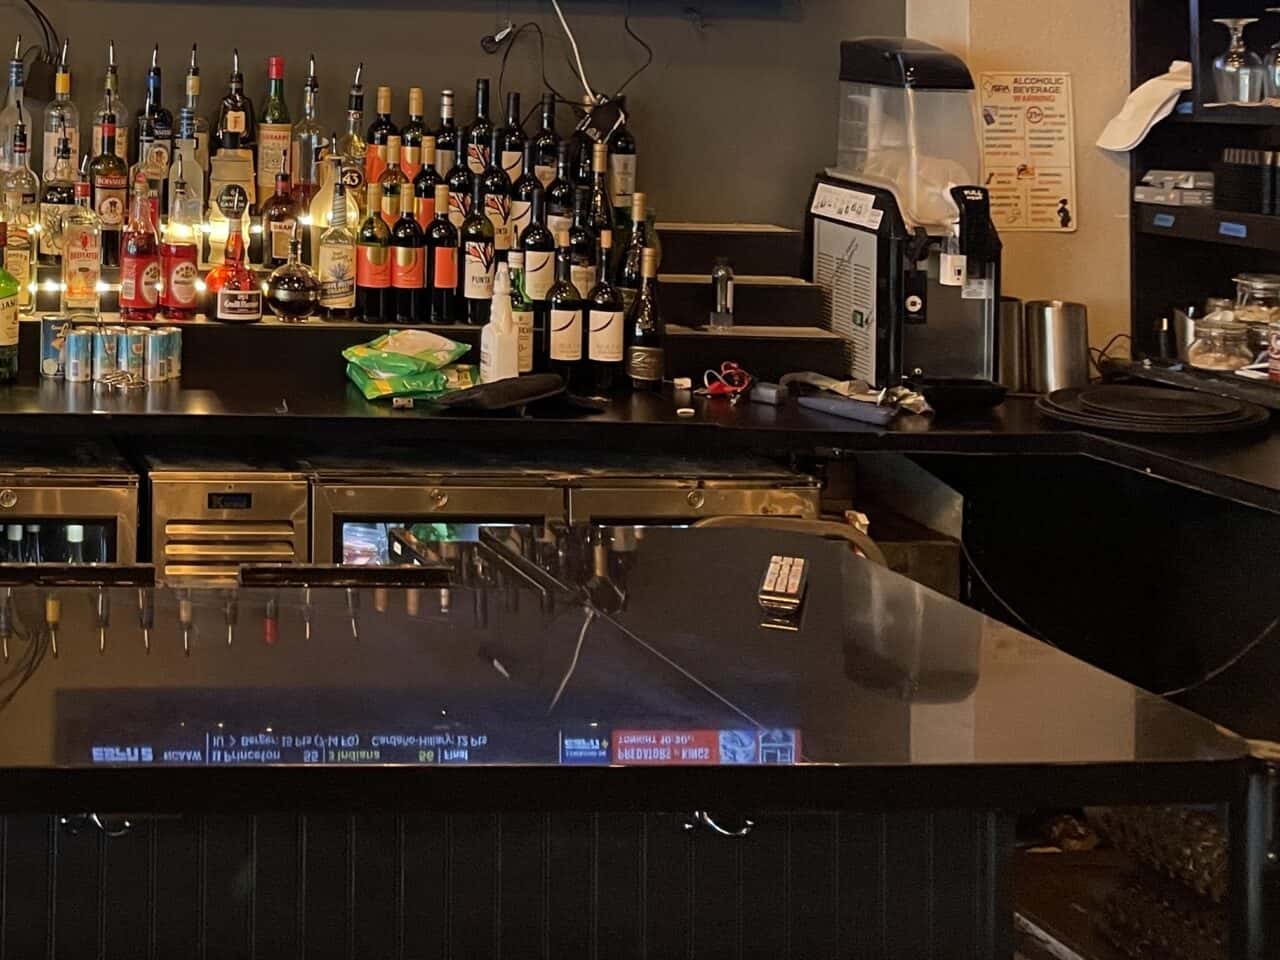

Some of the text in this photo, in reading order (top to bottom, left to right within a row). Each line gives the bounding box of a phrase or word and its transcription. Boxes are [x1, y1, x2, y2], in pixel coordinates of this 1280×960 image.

[1013, 77, 1064, 85] ALCOHOLIC
[1013, 86, 1061, 94] BEVERAGE
[342, 174, 358, 185] 43
